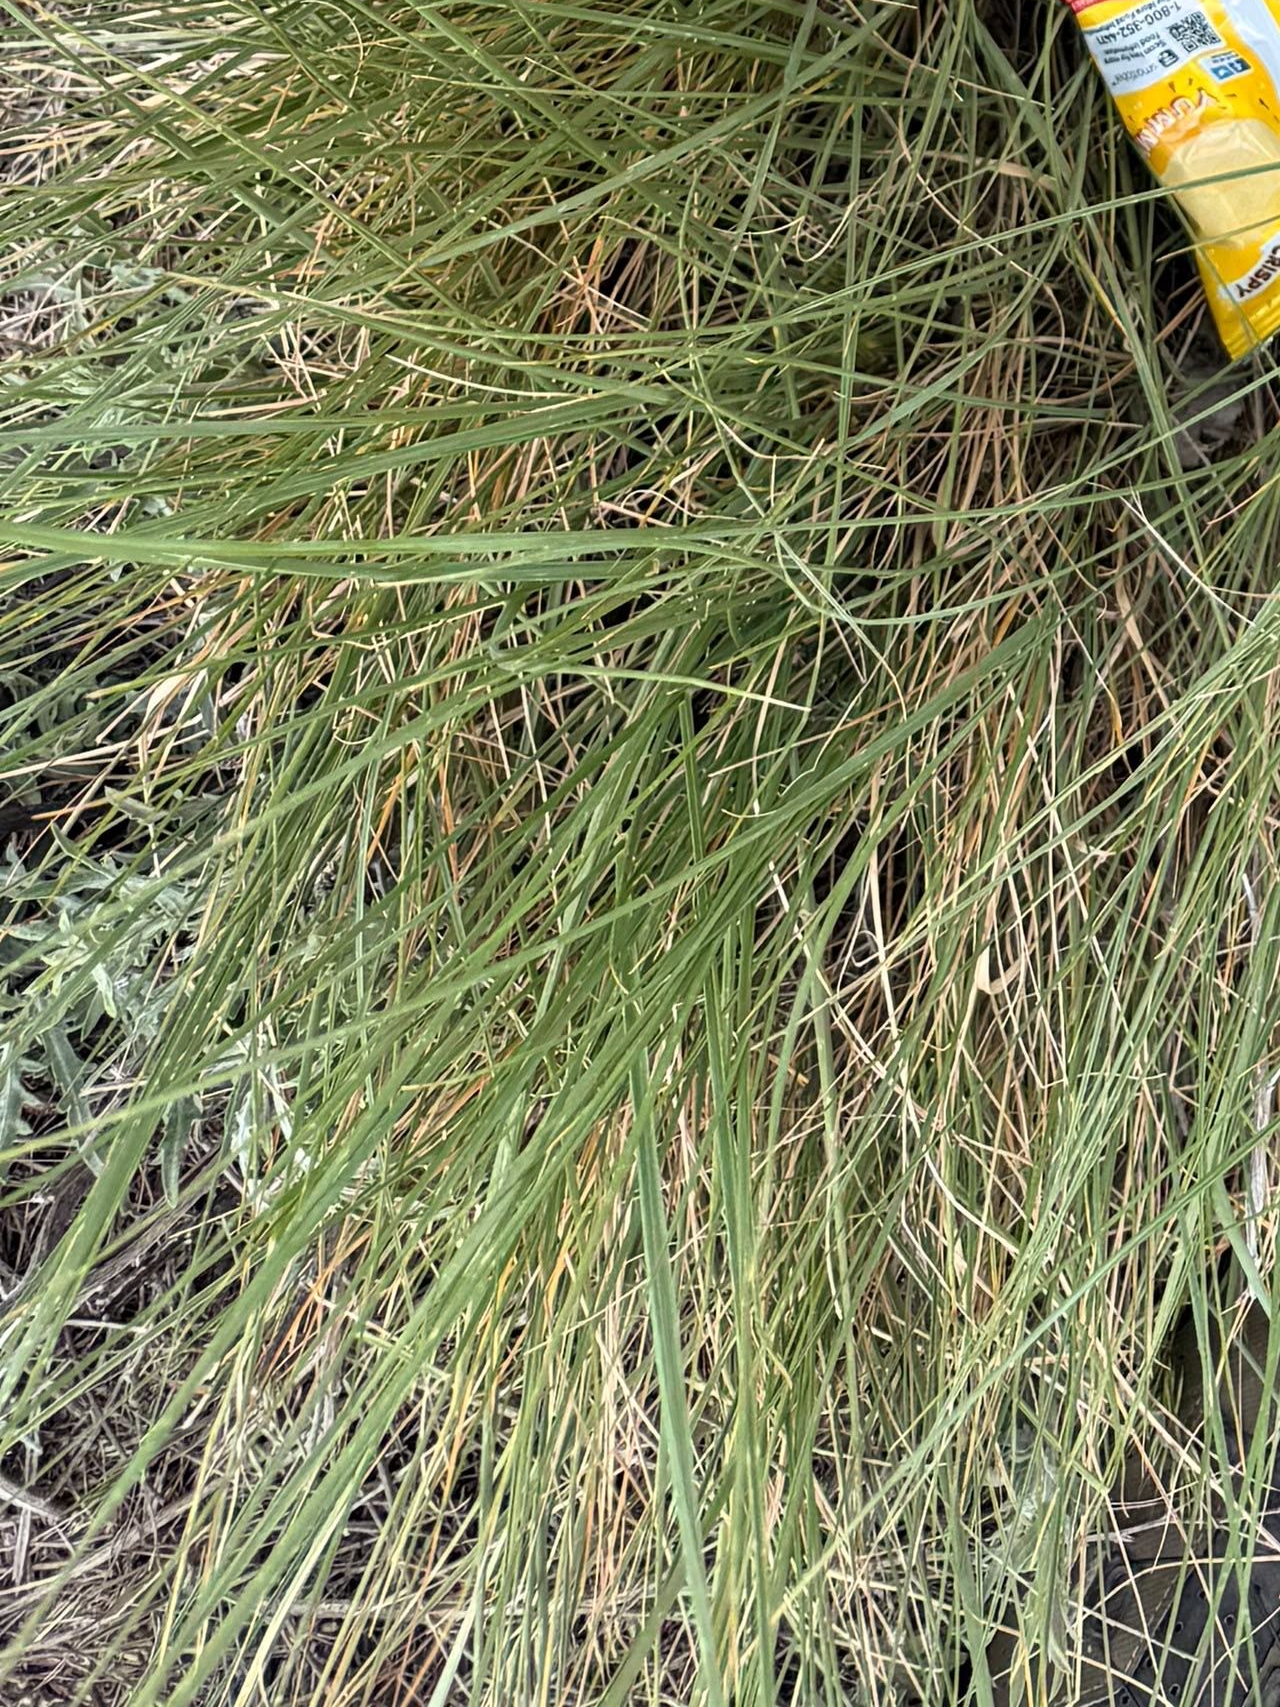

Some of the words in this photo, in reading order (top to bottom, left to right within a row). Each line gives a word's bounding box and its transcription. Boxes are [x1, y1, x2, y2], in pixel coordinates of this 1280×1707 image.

[1095, 0, 1181, 47] 1-800-352-4477
[1138, 31, 1160, 46] food
[1142, 36, 1166, 57] Scan
[1132, 85, 1220, 157] YUMM
